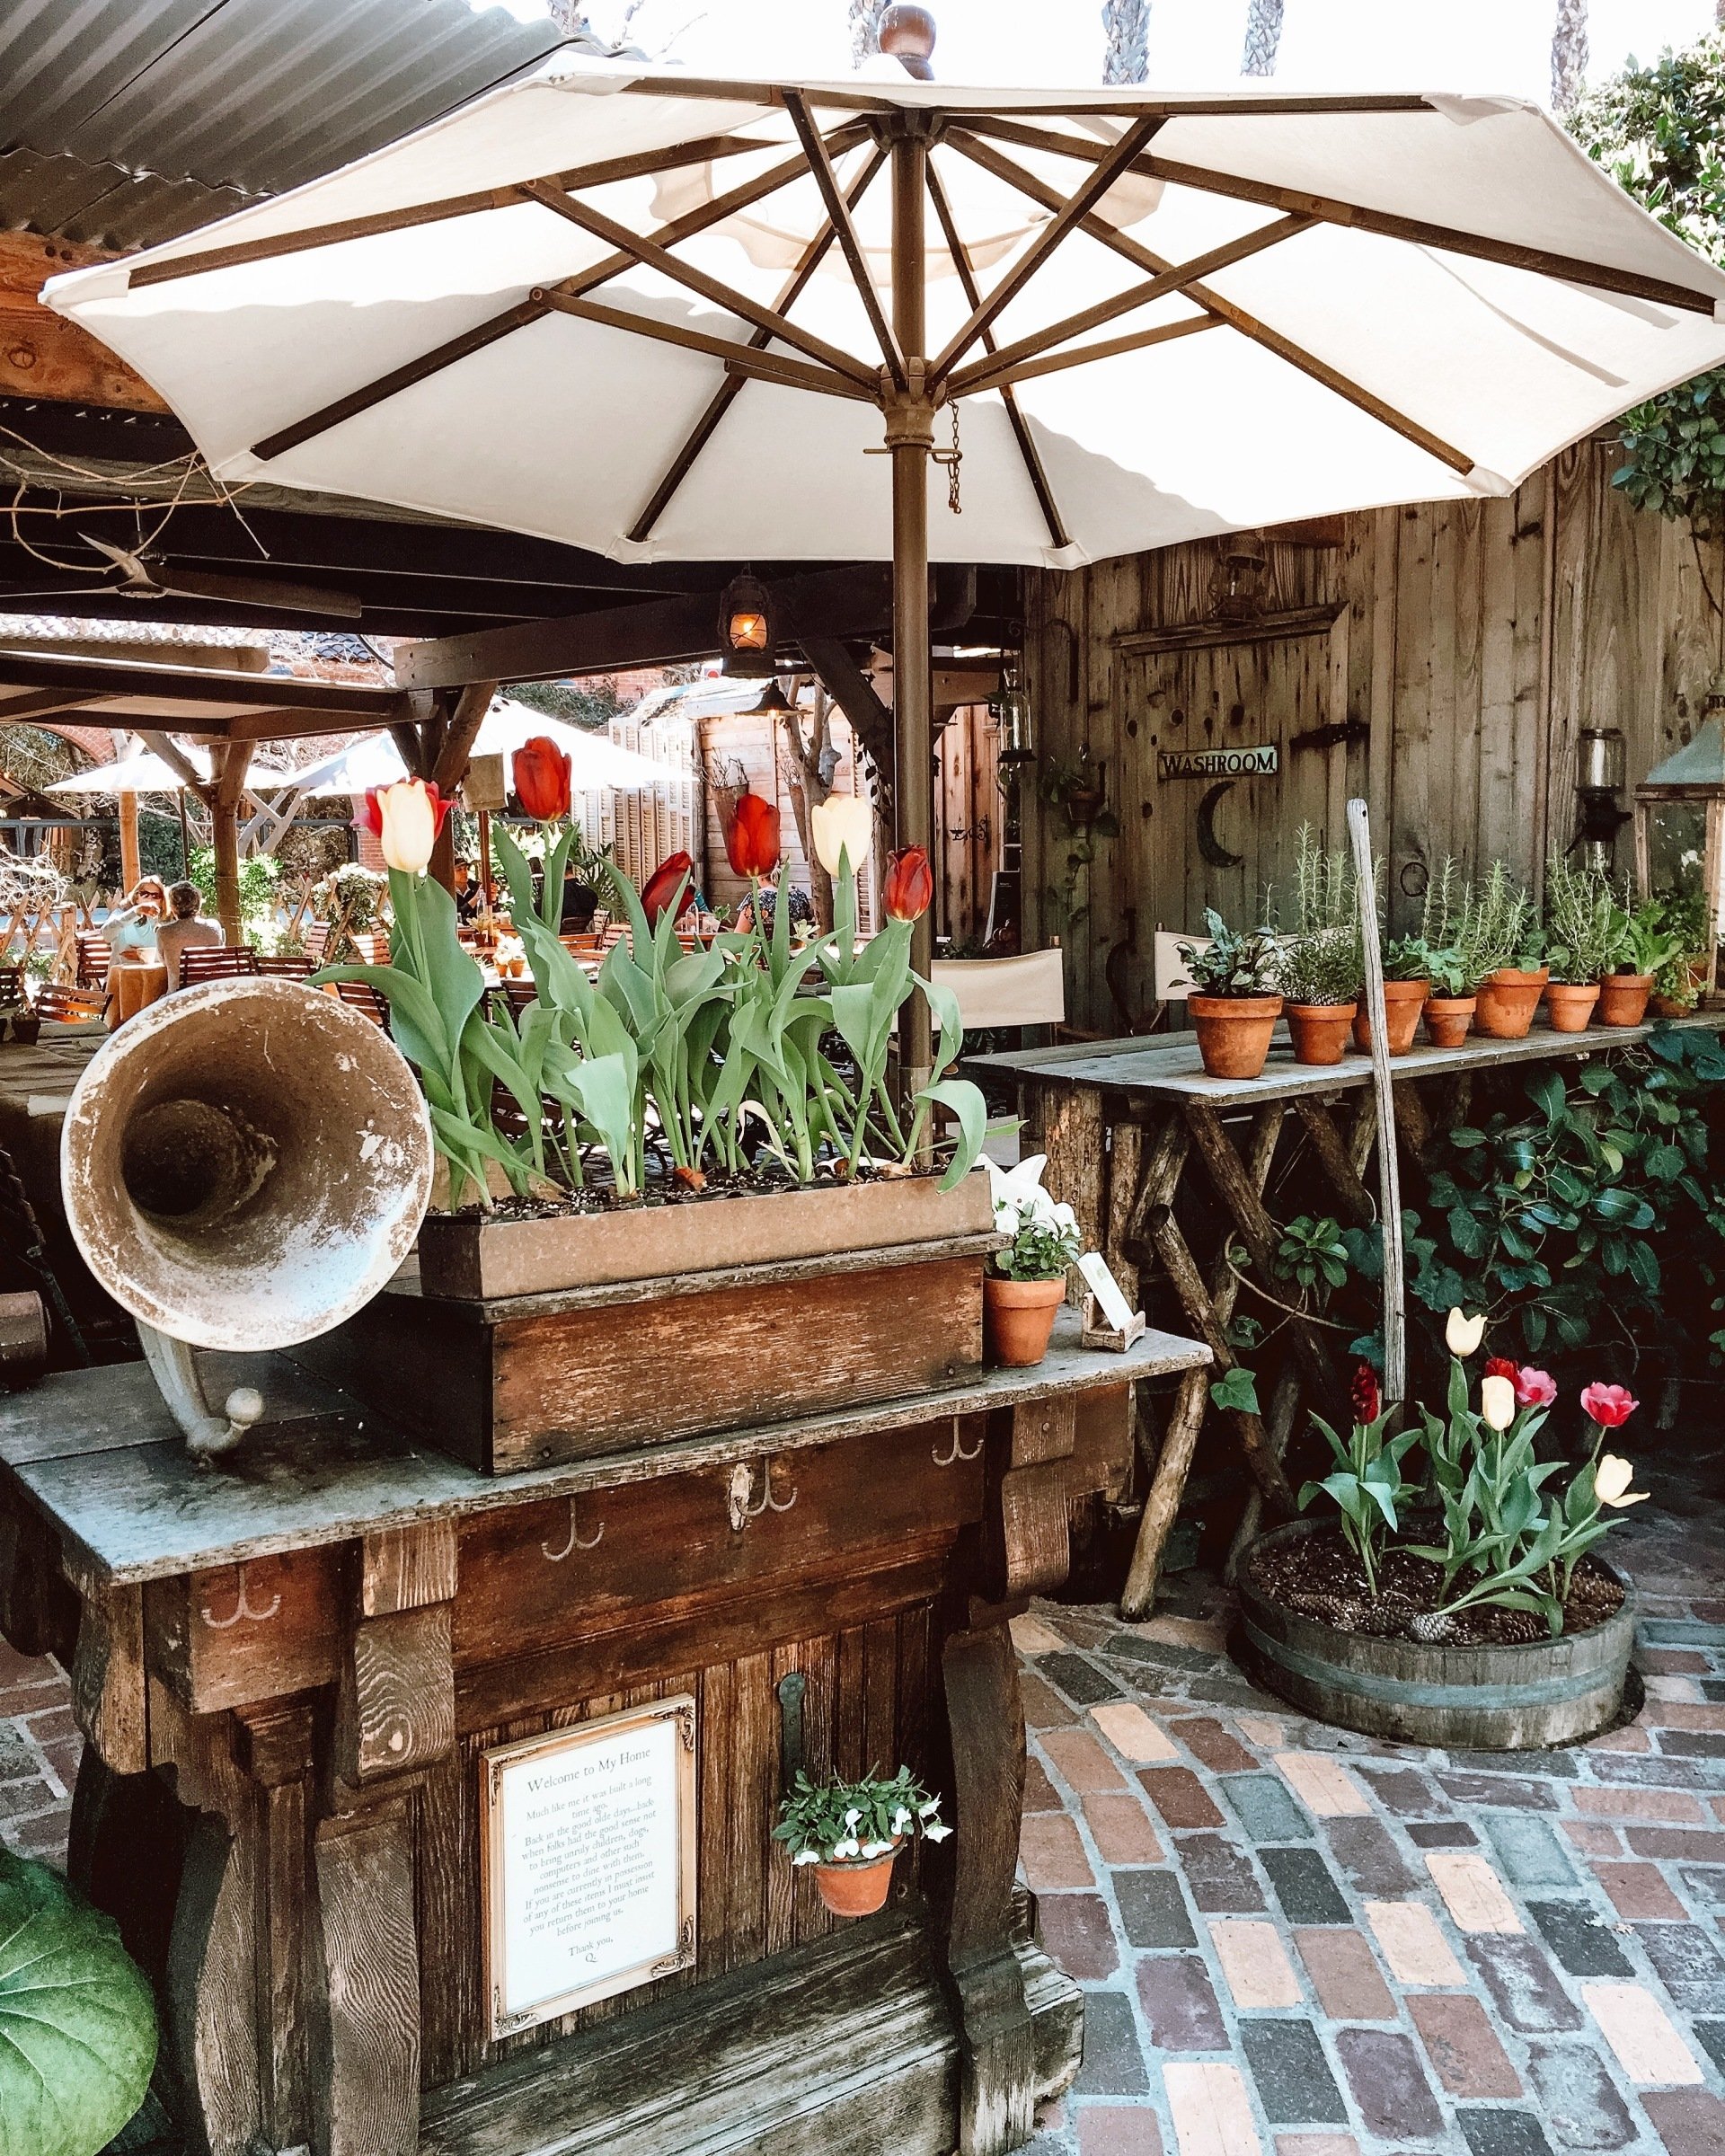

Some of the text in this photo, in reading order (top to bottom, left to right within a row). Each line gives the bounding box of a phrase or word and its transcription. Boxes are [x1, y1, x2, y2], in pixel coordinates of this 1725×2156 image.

[1163, 751, 1275, 773] WASHROOM
[527, 1749, 650, 1792] Welcome to My Home
[526, 1806, 549, 1821] Much
[552, 1802, 565, 1813] like
[568, 1798, 580, 1807] me
[583, 1794, 588, 1803] it
[592, 1790, 606, 1799] was
[609, 1782, 626, 1794] built
[635, 1776, 651, 1787] long
[572, 1807, 589, 1818] time
[521, 1810, 656, 1860] when folks had the good sense not
[525, 1833, 544, 1847] Back
[546, 1832, 553, 1840] in
[557, 1826, 570, 1836] the
[571, 1817, 591, 1834] good
[595, 1813, 611, 1824] olde
[529, 1862, 538, 1870] to
[541, 1854, 562, 1865] bring
[564, 1843, 589, 1860] unruly
[629, 1827, 649, 1838] dogs,
[534, 1852, 645, 1895] nonsense to dine with them.
[540, 1839, 640, 1879] computers and other such
[523, 1871, 655, 1923] of any of these items I must insist
[525, 1860, 652, 1910] If you are currently in possession
[529, 1886, 649, 1937] you return them to your home
[557, 1922, 581, 1936] before
[584, 1913, 611, 1931] joining
[568, 1936, 614, 1957] Thank you,
